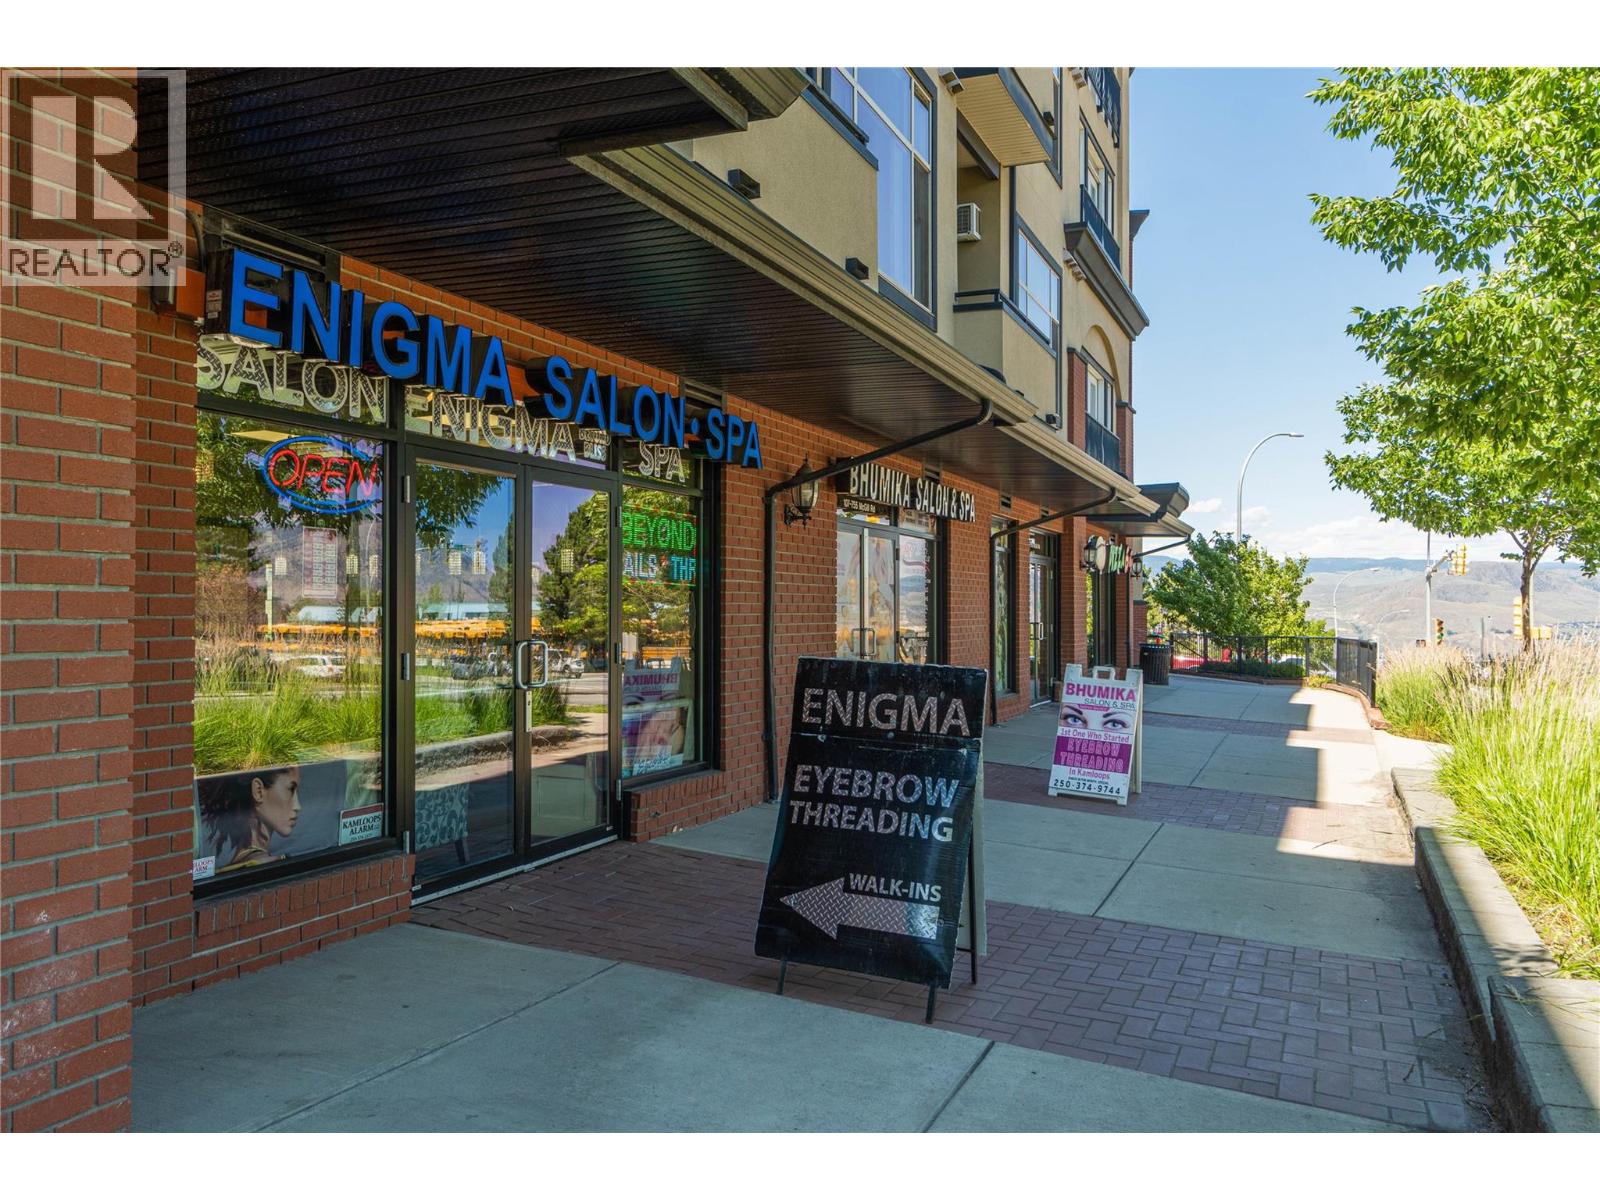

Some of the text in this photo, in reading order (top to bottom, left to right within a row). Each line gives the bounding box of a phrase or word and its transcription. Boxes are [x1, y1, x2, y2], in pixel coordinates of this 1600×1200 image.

[229, 248, 763, 470] ENIGMA SALON SPA
[196, 333, 686, 483] SALON ENIGMA SPA
[268, 449, 378, 497] OPEN
[850, 461, 911, 508] BHUMIKA
[915, 477, 950, 518] SALON
[950, 489, 958, 520] &
[958, 490, 977, 523] SPA
[622, 511, 697, 551] BEYOND
[621, 551, 657, 578] AILS
[1065, 682, 1137, 702] BHUMIKA
[1084, 697, 1110, 707] SALON
[1112, 700, 1118, 709] &
[1120, 701, 1136, 710] SPA
[802, 687, 971, 737] ENIGMA
[1061, 727, 1130, 744] 1st One Who Started
[1067, 738, 1121, 758] EYEBROW
[1059, 750, 1124, 773] THREADING
[1068, 767, 1076, 775] In
[1077, 768, 1111, 781] Kamloops
[793, 764, 960, 809] EYEBROW
[342, 815, 382, 830] KAMLOOPS
[349, 824, 374, 836] ALARM
[789, 799, 954, 842] THREADING
[849, 872, 942, 902] WALK-INS
